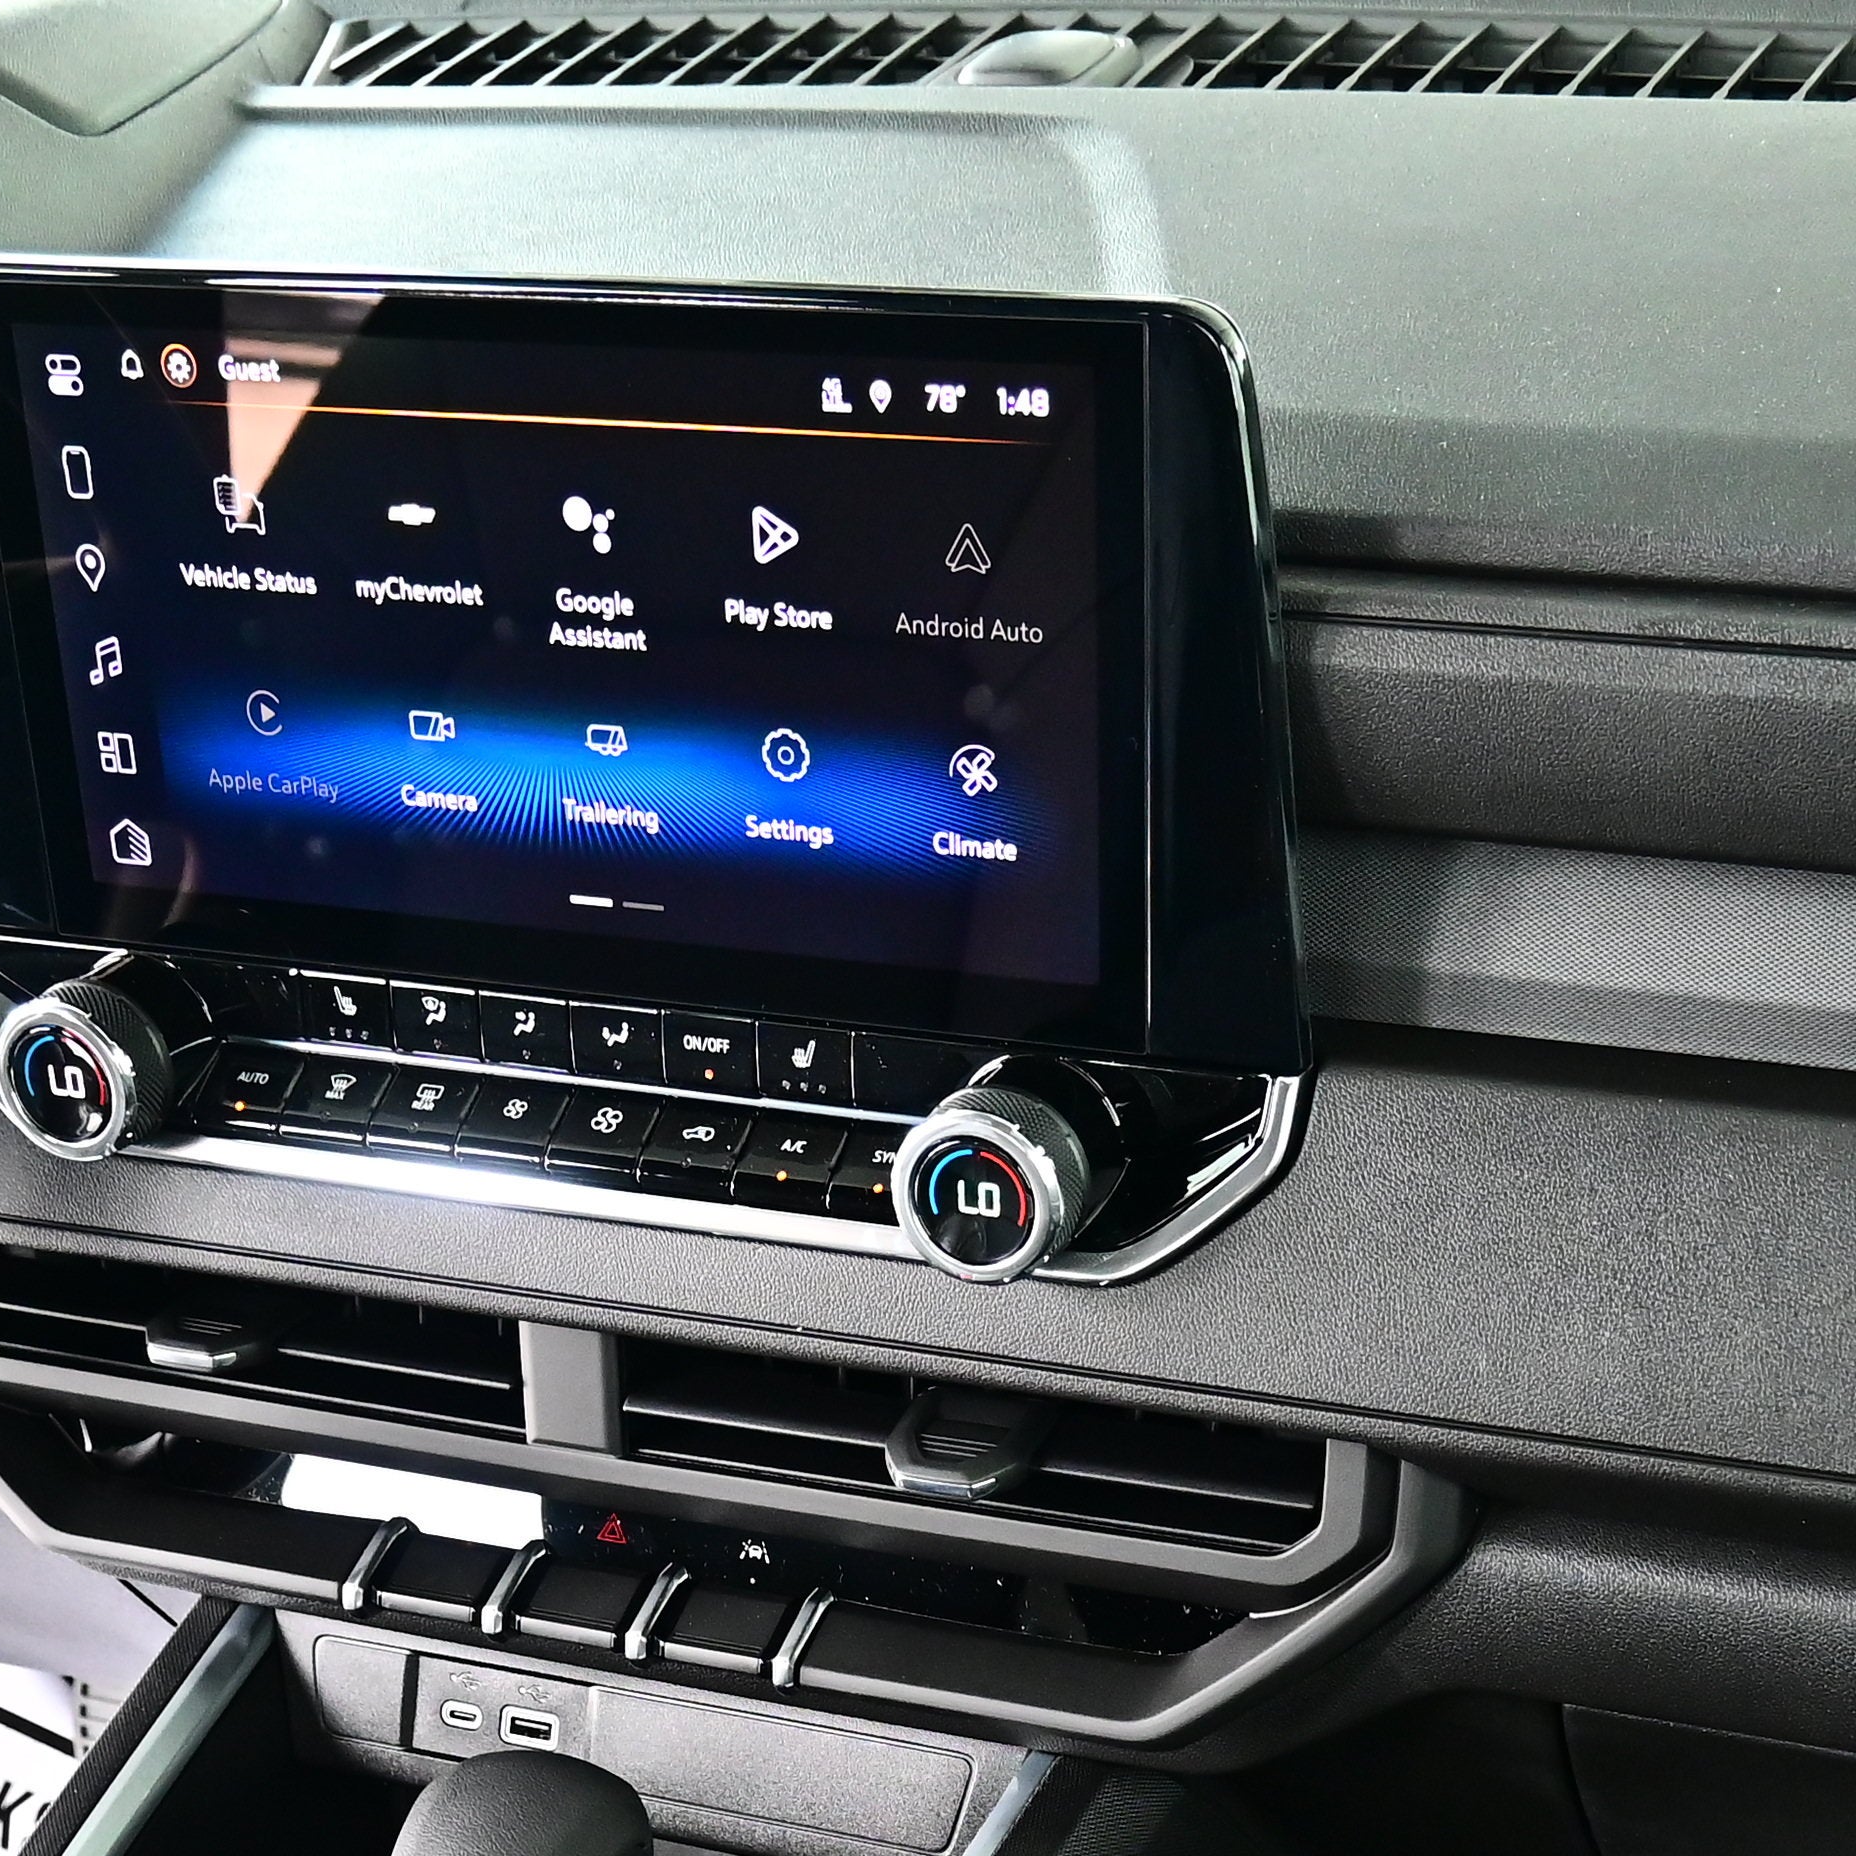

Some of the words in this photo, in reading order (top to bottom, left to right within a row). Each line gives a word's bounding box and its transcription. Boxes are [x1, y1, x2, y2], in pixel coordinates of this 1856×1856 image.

[218, 354, 281, 382] Guest
[996, 386, 1050, 418] 1:48
[179, 563, 251, 591] Vehicle
[254, 567, 317, 595] Status
[355, 576, 484, 606] myChevrolet
[555, 587, 634, 621] Google
[724, 599, 770, 631] Play
[773, 602, 833, 631] Store
[549, 621, 647, 652] Assistant
[895, 612, 985, 640] Android
[990, 618, 1044, 644] Auto
[208, 767, 263, 795] Apple
[267, 772, 340, 804] CarPlay
[400, 784, 478, 813] Camera
[561, 797, 660, 835] Trailering
[745, 814, 834, 850] Settings
[932, 831, 1018, 862] Climate
[682, 1035, 730, 1054] ON/OFF
[237, 1070, 269, 1085] AUTO
[325, 1088, 345, 1100] MAX
[411, 1100, 436, 1112] REAR
[780, 1139, 807, 1154] A/C
[872, 1149, 897, 1164] SYN
[956, 1179, 1001, 1218] LO
